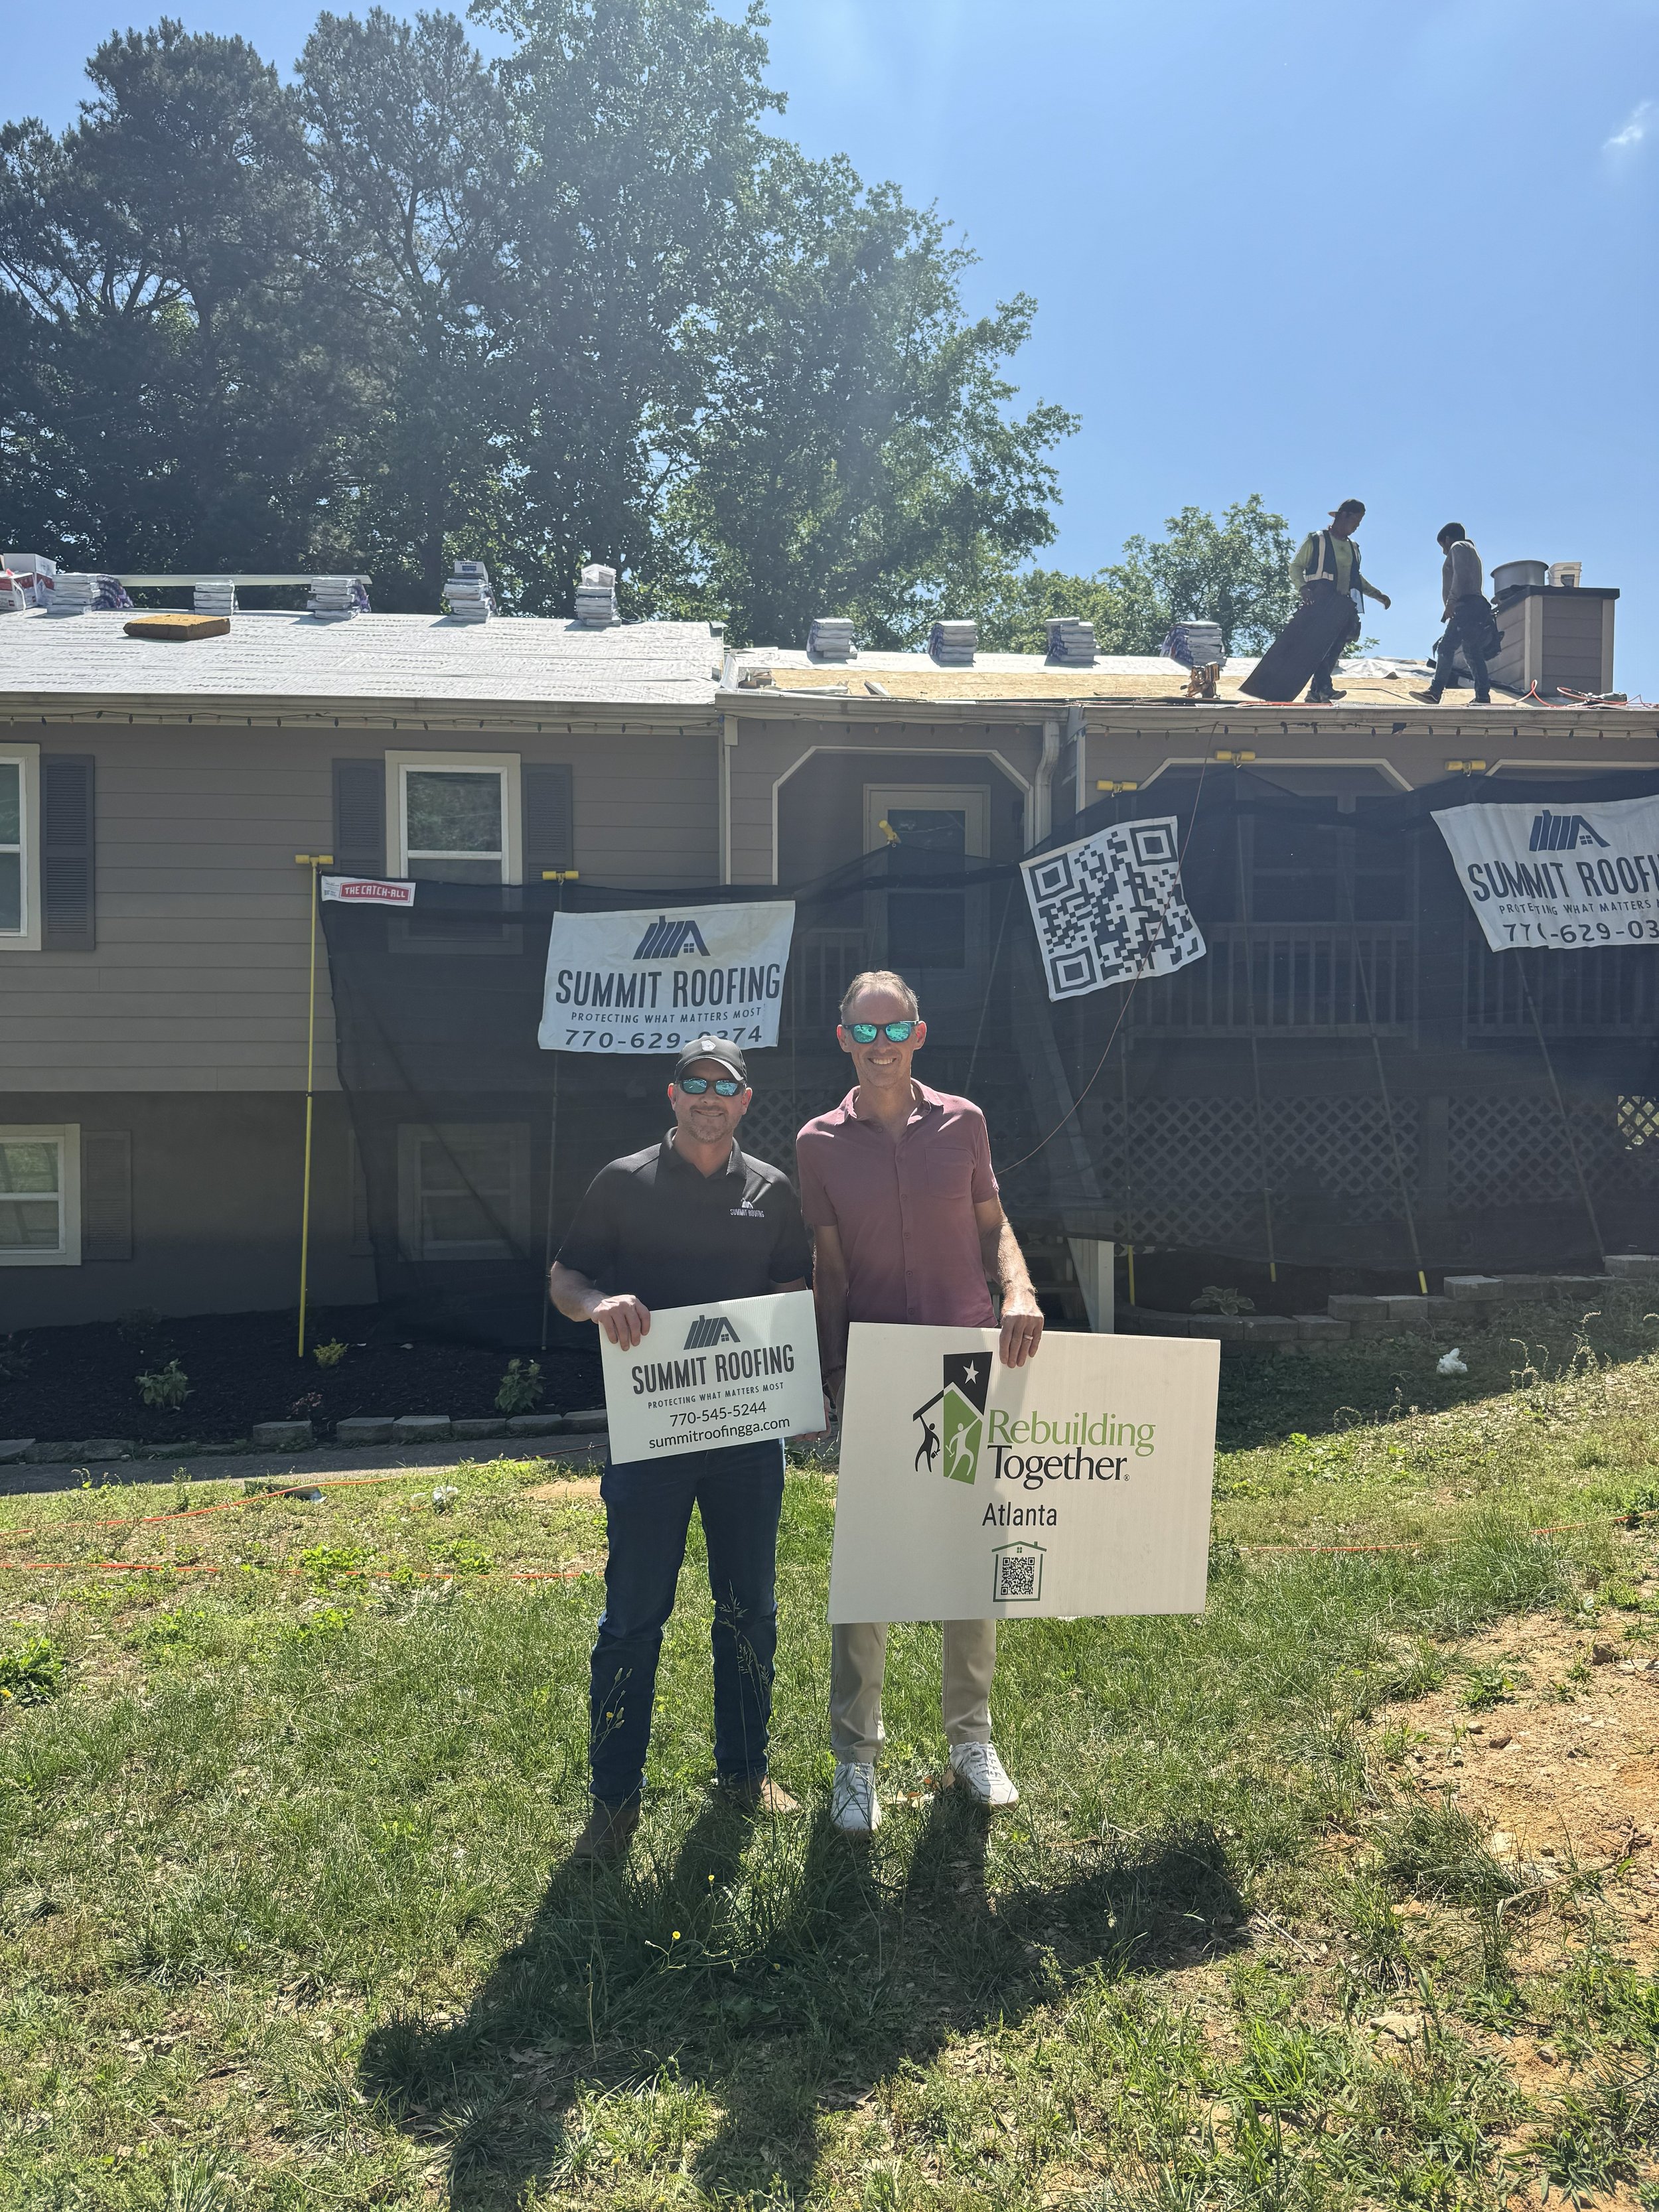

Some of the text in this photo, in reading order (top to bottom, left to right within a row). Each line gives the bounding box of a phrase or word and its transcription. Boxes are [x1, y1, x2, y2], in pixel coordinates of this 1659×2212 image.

[1467, 853, 1659, 902] SUMMIT ROOFI
[345, 885, 360, 895] THE
[361, 885, 406, 898] CATCH-ALL
[1499, 903, 1558, 915] PROTETING
[1563, 903, 1593, 915] WHAT
[1600, 899, 1652, 913] MATTERS
[555, 963, 780, 1008] SUMMIT ROOFING
[571, 1007, 760, 1023] PROTECTING WHAT MATTERS MOST
[632, 1344, 794, 1394] SUMMIT ROOFING
[648, 1382, 784, 1409] PROTECTING WHAT MATTERS MOST
[670, 1401, 766, 1427] 770-545-5244
[649, 1418, 790, 1449] summitroofingga.com
[987, 1409, 1155, 1457] Rebuilding
[982, 1501, 1057, 1526] Atlanta
